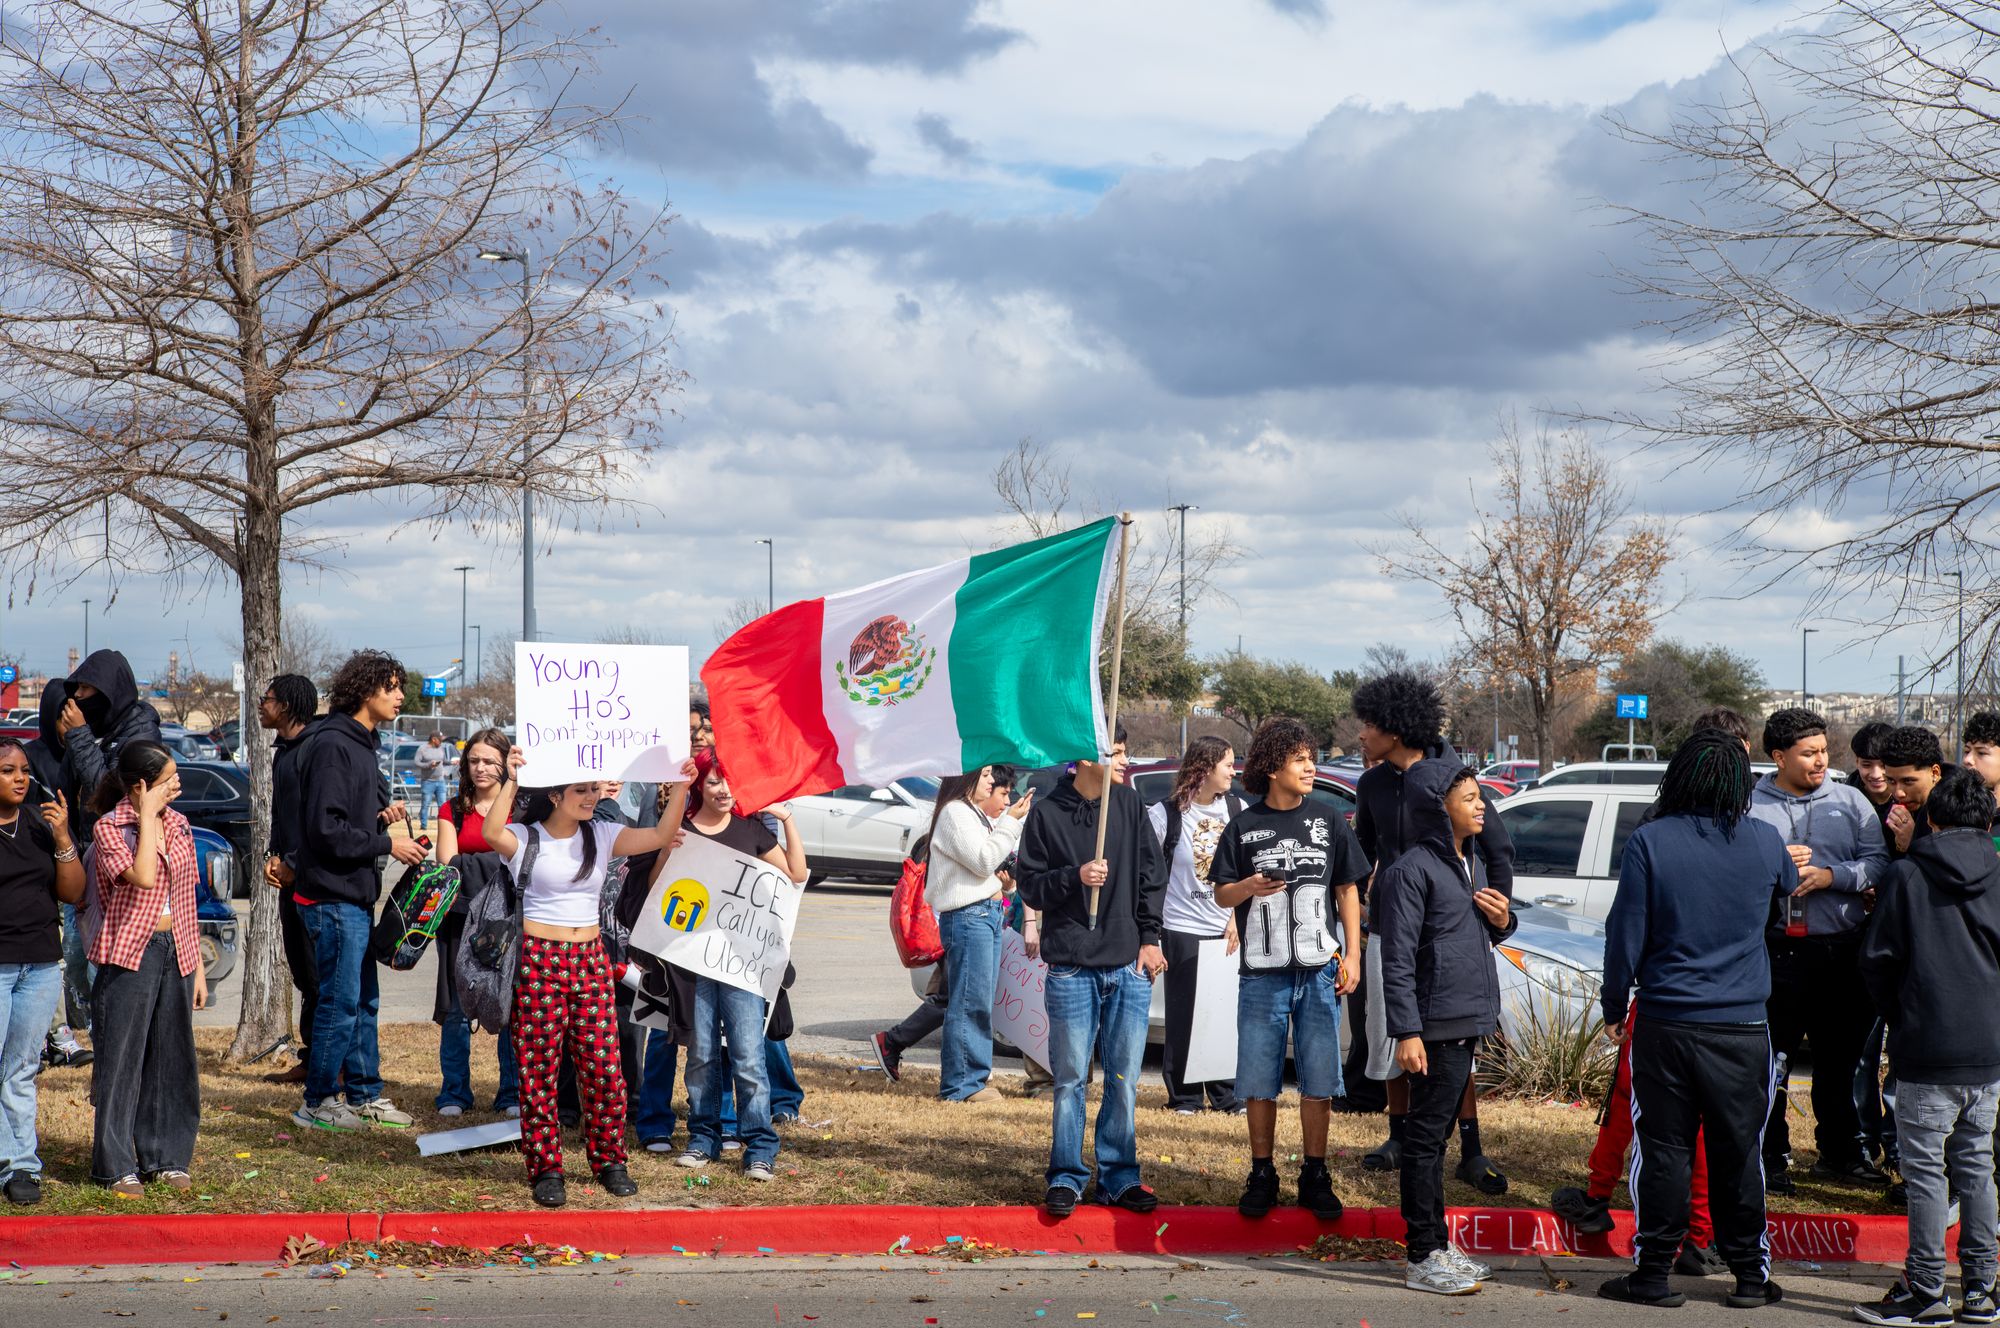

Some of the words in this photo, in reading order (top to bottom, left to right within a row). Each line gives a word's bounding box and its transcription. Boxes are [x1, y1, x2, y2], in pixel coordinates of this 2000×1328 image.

[529, 652, 619, 697] Young
[586, 721, 661, 749] Support
[577, 743, 603, 771] ICE!
[721, 859, 788, 921] ICE
[716, 902, 757, 937] Call
[1244, 884, 1341, 970] 08
[703, 935, 773, 989] Uber
[1508, 1215, 1589, 1253] LANE
[1766, 1220, 1854, 1255] RKING
